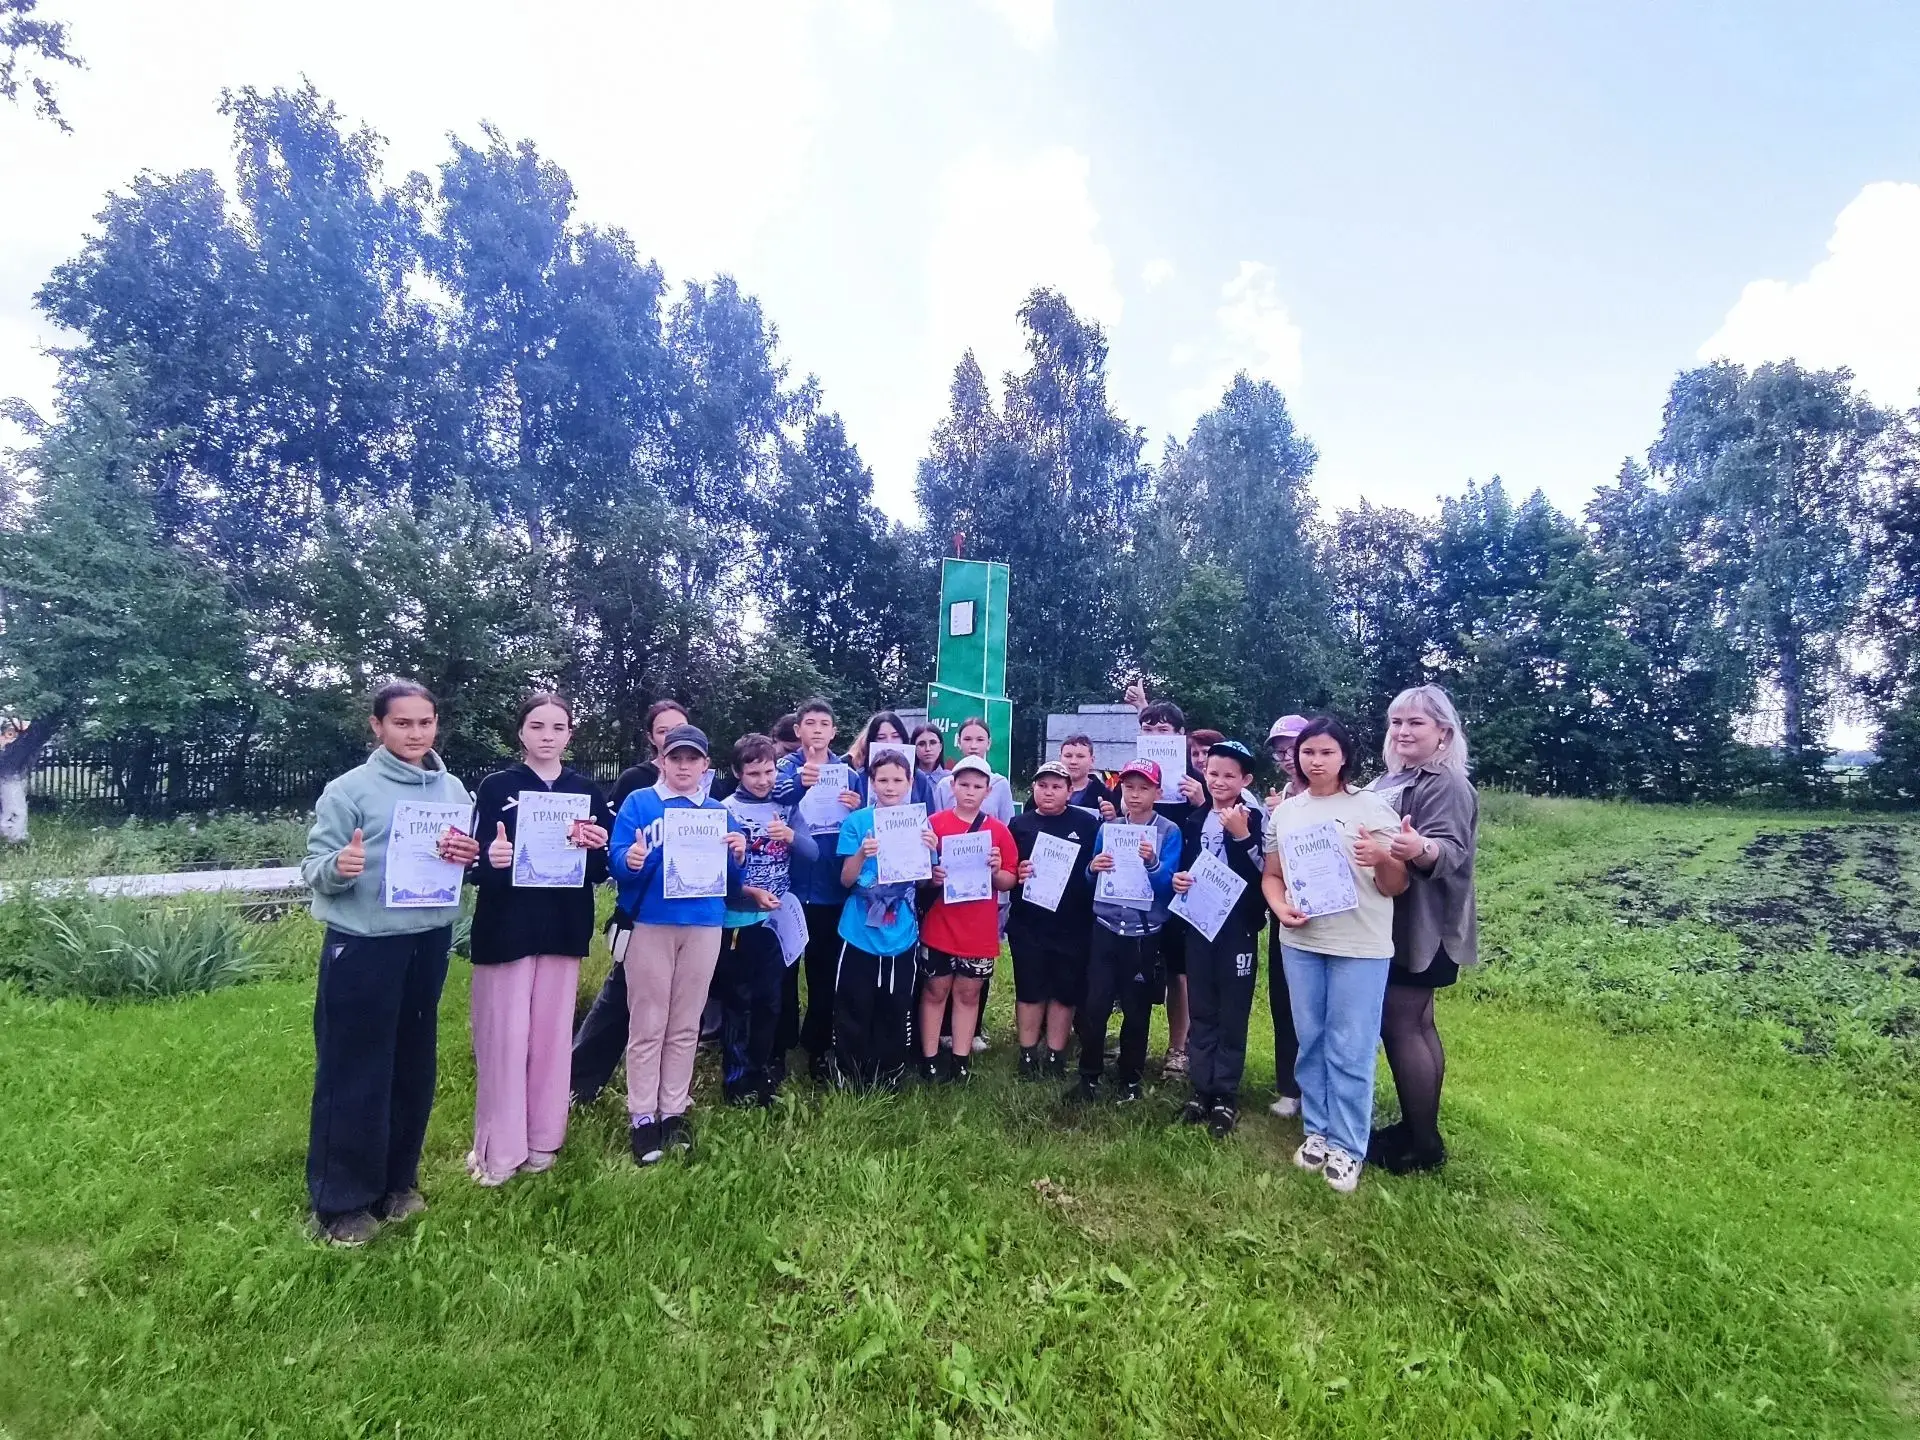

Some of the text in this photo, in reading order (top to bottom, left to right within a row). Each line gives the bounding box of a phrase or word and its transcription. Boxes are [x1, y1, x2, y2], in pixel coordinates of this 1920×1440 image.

[1147, 748, 1178, 758] ГРАМОТА
[818, 777, 839, 786] МОТА
[410, 821, 443, 835] ГРАМ
[678, 825, 720, 837] ГРАМОТА
[885, 817, 918, 831] ГРАМОТА
[1114, 837, 1139, 848] ГРАМО
[1294, 838, 1332, 857] ГРАМОТА
[953, 844, 984, 857] ГРАМОТА
[1042, 847, 1070, 863] ГРАМОТА
[1201, 867, 1232, 896] ГРАМОТА
[1236, 952, 1253, 970] 97
